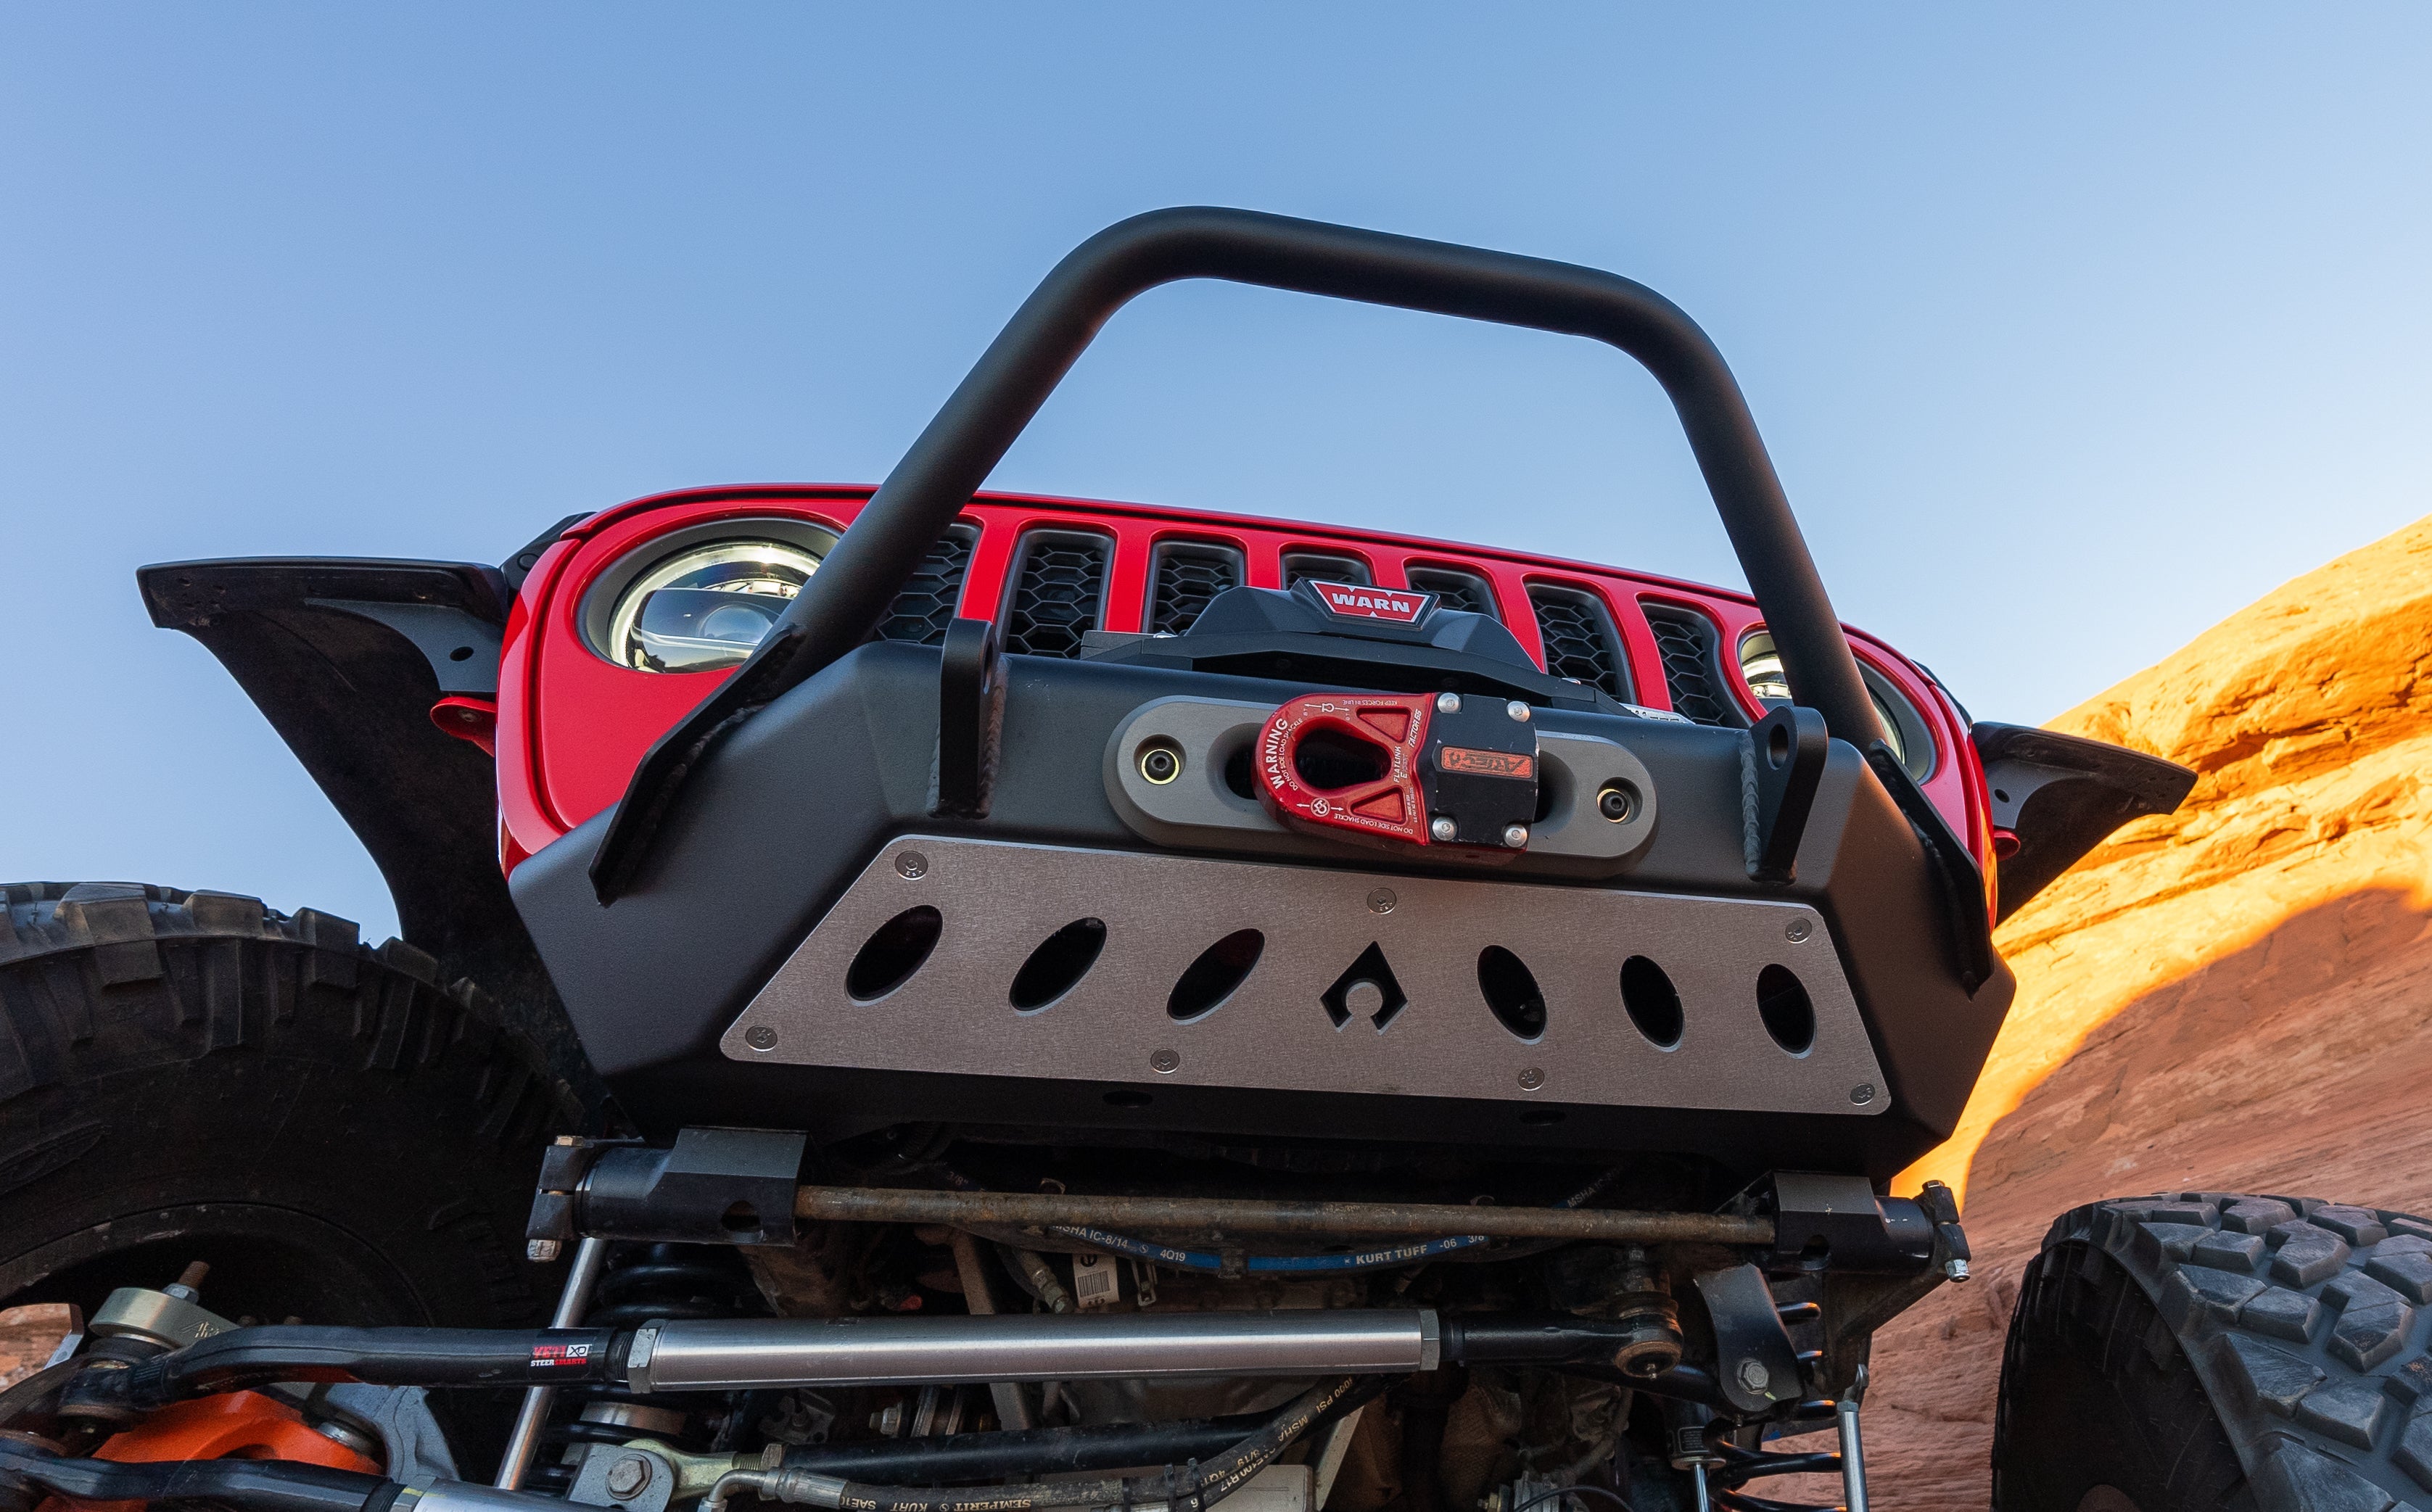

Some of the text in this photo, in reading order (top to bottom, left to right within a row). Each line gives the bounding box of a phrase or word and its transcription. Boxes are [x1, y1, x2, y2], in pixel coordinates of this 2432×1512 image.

[1332, 592, 1411, 614] WARN
[1266, 718, 1288, 789] WARNING
[1282, 769, 1291, 782] NOT
[1289, 781, 1299, 791] DO
[1052, 1225, 1087, 1239] SHA
[1089, 1230, 1129, 1249] IC-8/14
[1160, 1249, 1187, 1262] 4Q19
[1356, 1251, 1392, 1265] KURT
[1395, 1244, 1428, 1259] TUFF
[1315, 1395, 1334, 1413] PSI
[1278, 1416, 1309, 1442] MSHA
[1201, 1470, 1226, 1487] 4Q1
[1221, 1473, 1240, 1492] R17
[890, 1503, 928, 1512] KURT
[954, 1499, 1031, 1512] SEMPERIT
